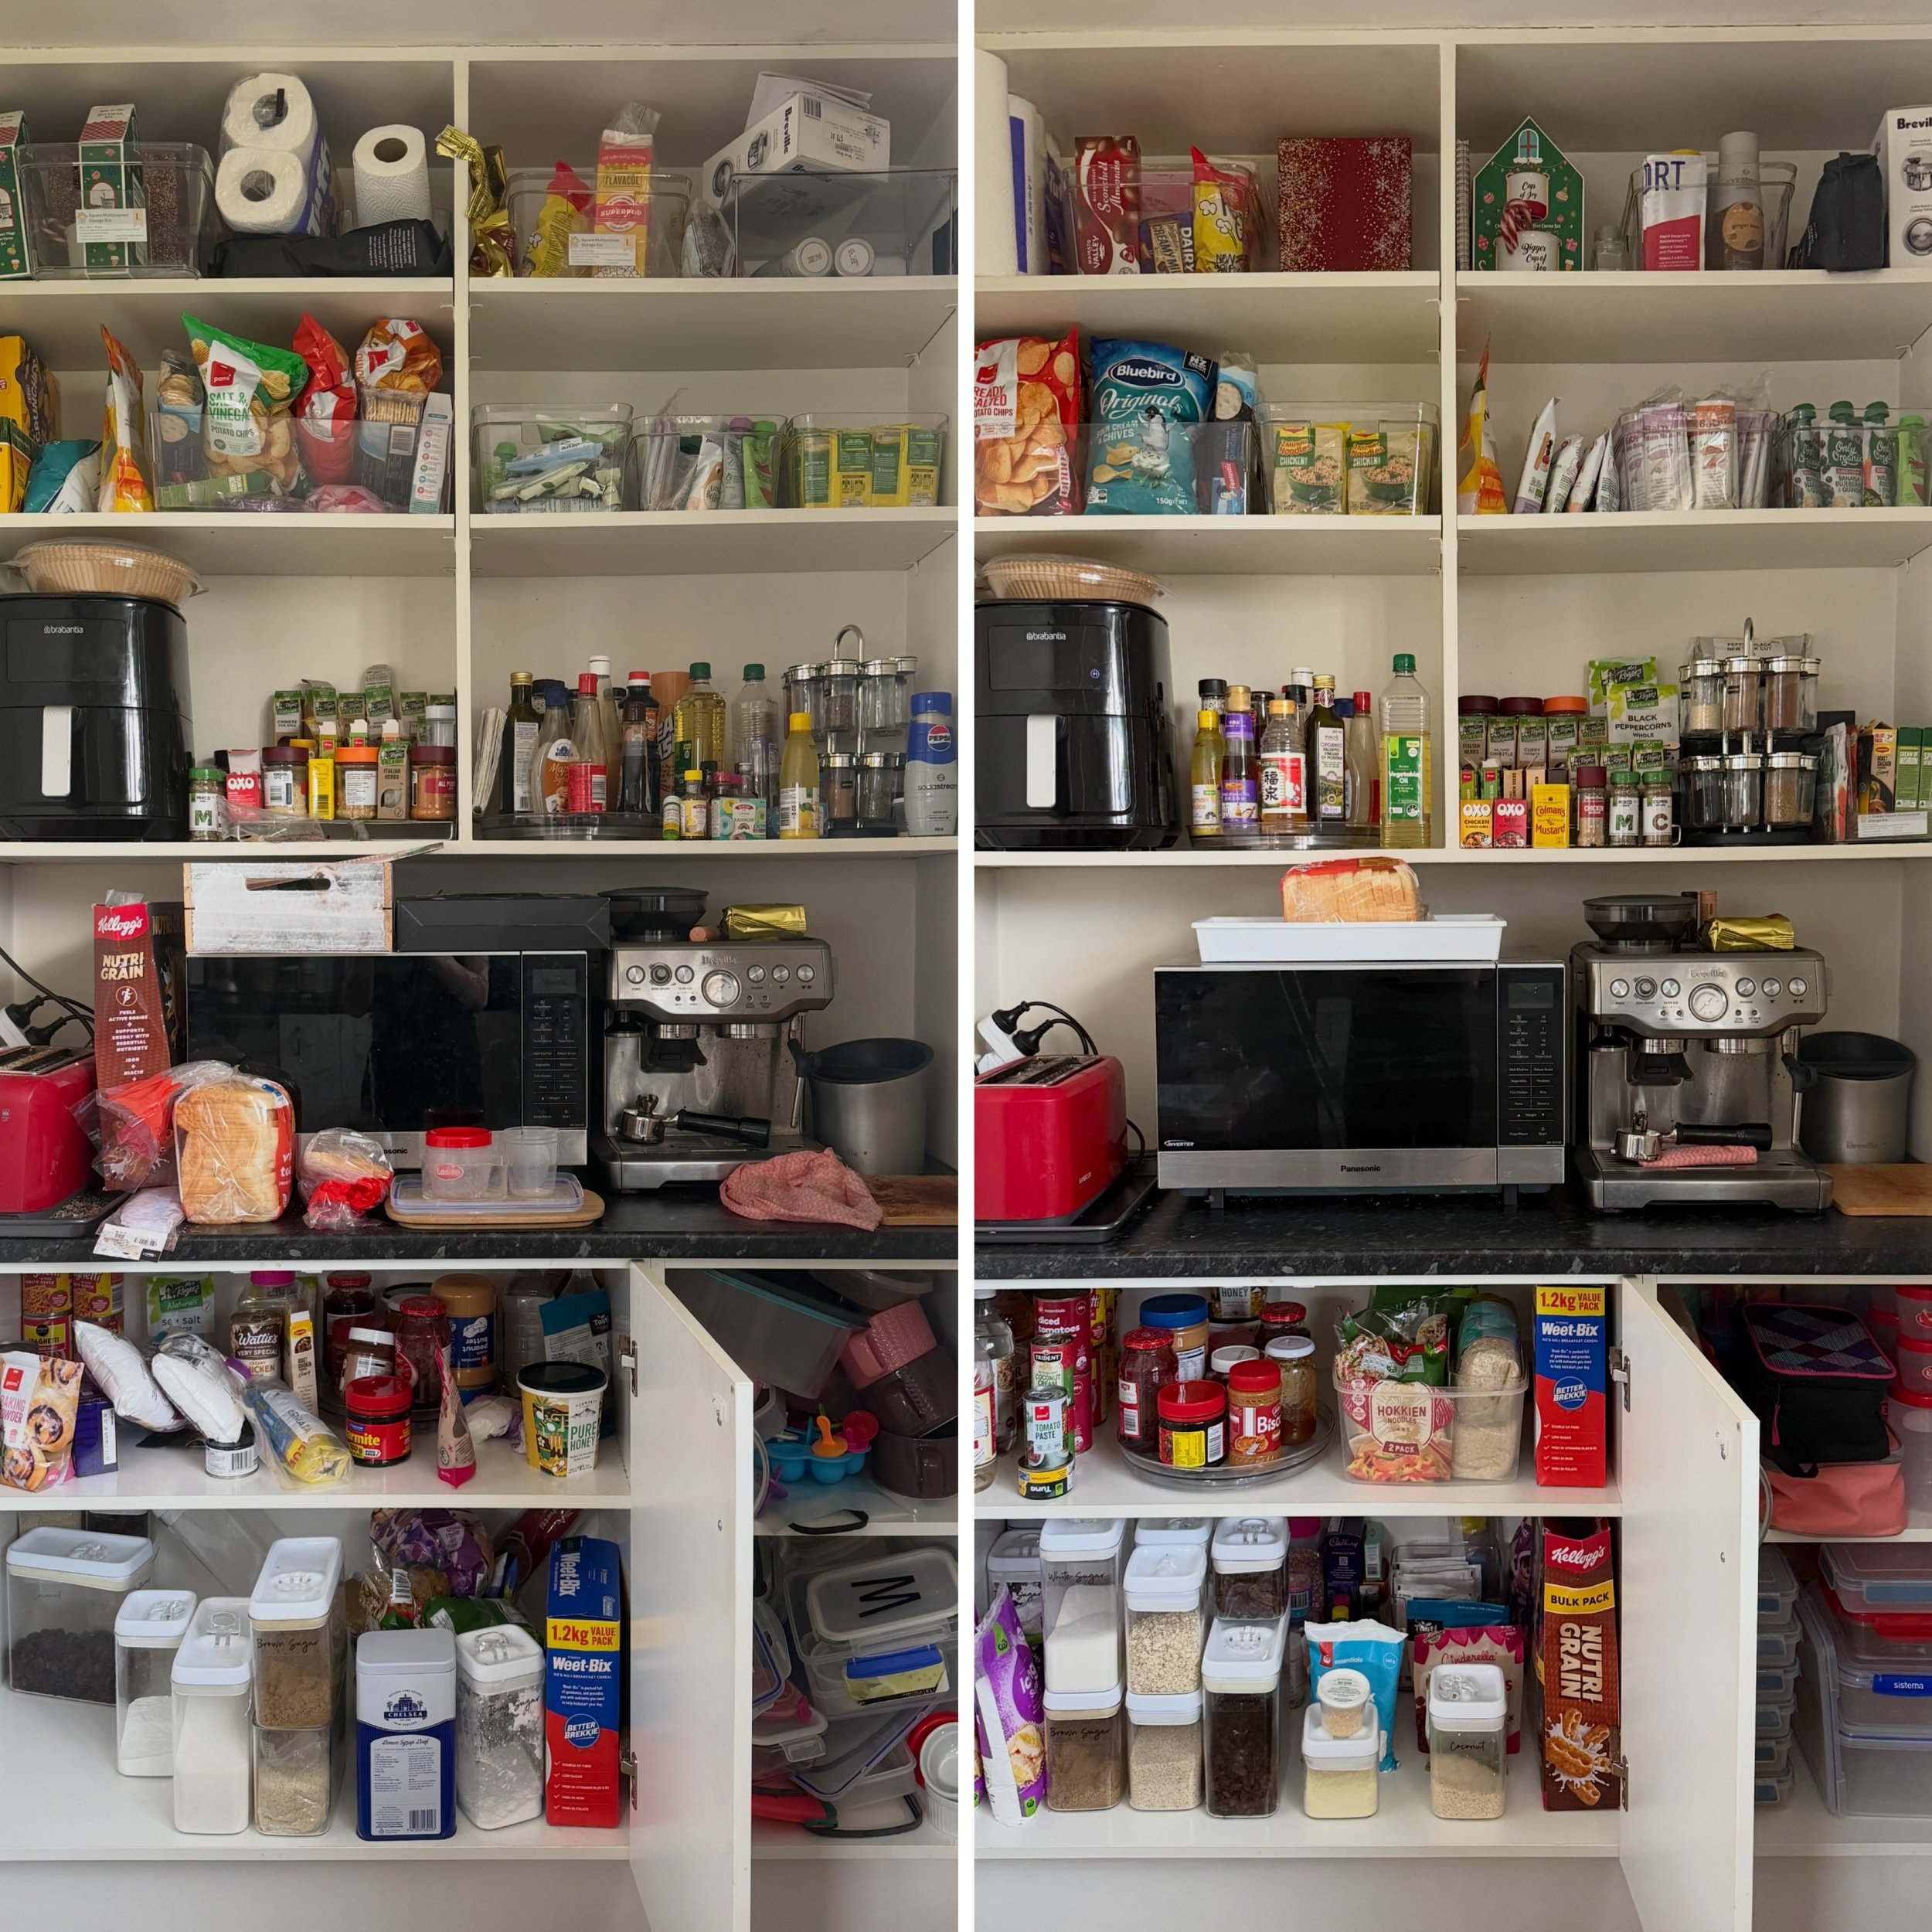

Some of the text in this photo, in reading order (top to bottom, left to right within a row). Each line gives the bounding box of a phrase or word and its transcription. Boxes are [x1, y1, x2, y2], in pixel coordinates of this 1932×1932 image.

[784, 106, 792, 155] Breville
[1097, 161, 1111, 213] Scorched
[1108, 159, 1124, 216] Almonds
[1522, 182, 1536, 191] Cup
[1091, 235, 1100, 269] VALLEY
[1181, 226, 1196, 272] DAIRY
[1521, 243, 1546, 255] Bigger
[1526, 254, 1540, 264] Cup
[1116, 364, 1177, 383] Bluebird
[209, 392, 235, 406] SALT
[1100, 387, 1183, 420] Originals
[993, 408, 1014, 417] CHIPS
[211, 425, 255, 438] POTATO CHIPS
[1103, 428, 1135, 442] CHIVES
[1278, 444, 1311, 456] Noodles
[1351, 446, 1384, 457] Noodles
[1835, 440, 1856, 455] Only
[1155, 497, 1173, 506] 150g
[49, 624, 83, 634] brabantia
[1032, 631, 1066, 641] brabantia
[1617, 668, 1643, 681] Rogers
[1639, 691, 1658, 700] Rogers
[1614, 721, 1672, 730] PEPPERCORNS
[226, 777, 255, 791] OXO
[1264, 770, 1280, 802] 福泉
[1462, 804, 1492, 817] OXO
[1497, 803, 1526, 817] OXO
[1536, 806, 1566, 817] Colman's
[194, 810, 213, 826] M
[1615, 814, 1634, 831] M
[1652, 813, 1668, 831] C
[1535, 824, 1566, 835] Mustard
[97, 915, 144, 937] Kellogg's
[102, 951, 145, 968] NUTRI
[702, 955, 736, 964] Breville
[100, 965, 145, 981] GRAIN
[1340, 1165, 1382, 1173] Panasonic
[175, 1284, 199, 1297] Rogers
[1221, 1287, 1249, 1298] HONEY
[166, 1298, 199, 1310] Naturals
[1539, 1291, 1602, 1311] 1.2kg VALUE
[1579, 1301, 1600, 1311] PACK
[182, 1315, 201, 1324] salt
[1038, 1316, 1060, 1325] diced
[1038, 1325, 1080, 1334] tomatoes
[1541, 1321, 1599, 1336] Weet-Bix
[238, 1332, 278, 1345] Wattie's
[462, 1343, 488, 1352] peanut
[1556, 1383, 1584, 1394] BETTER
[1553, 1390, 1587, 1402] BREKKIE
[1377, 1405, 1427, 1417] HOKKIEN
[570, 1420, 597, 1440] PURE
[1036, 1420, 1061, 1432] TOMATO
[1035, 1431, 1056, 1440] PASTE
[570, 1434, 597, 1452] HONEY
[1394, 1444, 1415, 1453] PACK
[1551, 1545, 1607, 1568] Kellogg's
[560, 1552, 580, 1597] Weet-Bix
[1048, 1570, 1105, 1583] White Sugar
[1550, 1591, 1610, 1607] BULK PACK
[551, 1625, 616, 1646] 1.2kg VALUE
[592, 1635, 613, 1646] PACK
[257, 1637, 319, 1652] Brown Sugar
[1440, 1650, 1497, 1664] Cinderella
[1560, 1622, 1581, 1700] GRAIN
[1580, 1623, 1604, 1703] NUTRI
[553, 1656, 613, 1672] Weet-Bix
[1893, 1680, 1924, 1689] sistema
[567, 1721, 596, 1733] BETTER
[1049, 1727, 1111, 1740] Brown Sugar
[564, 1728, 600, 1740] BREKKIE
[1450, 1741, 1486, 1751] Coconut
